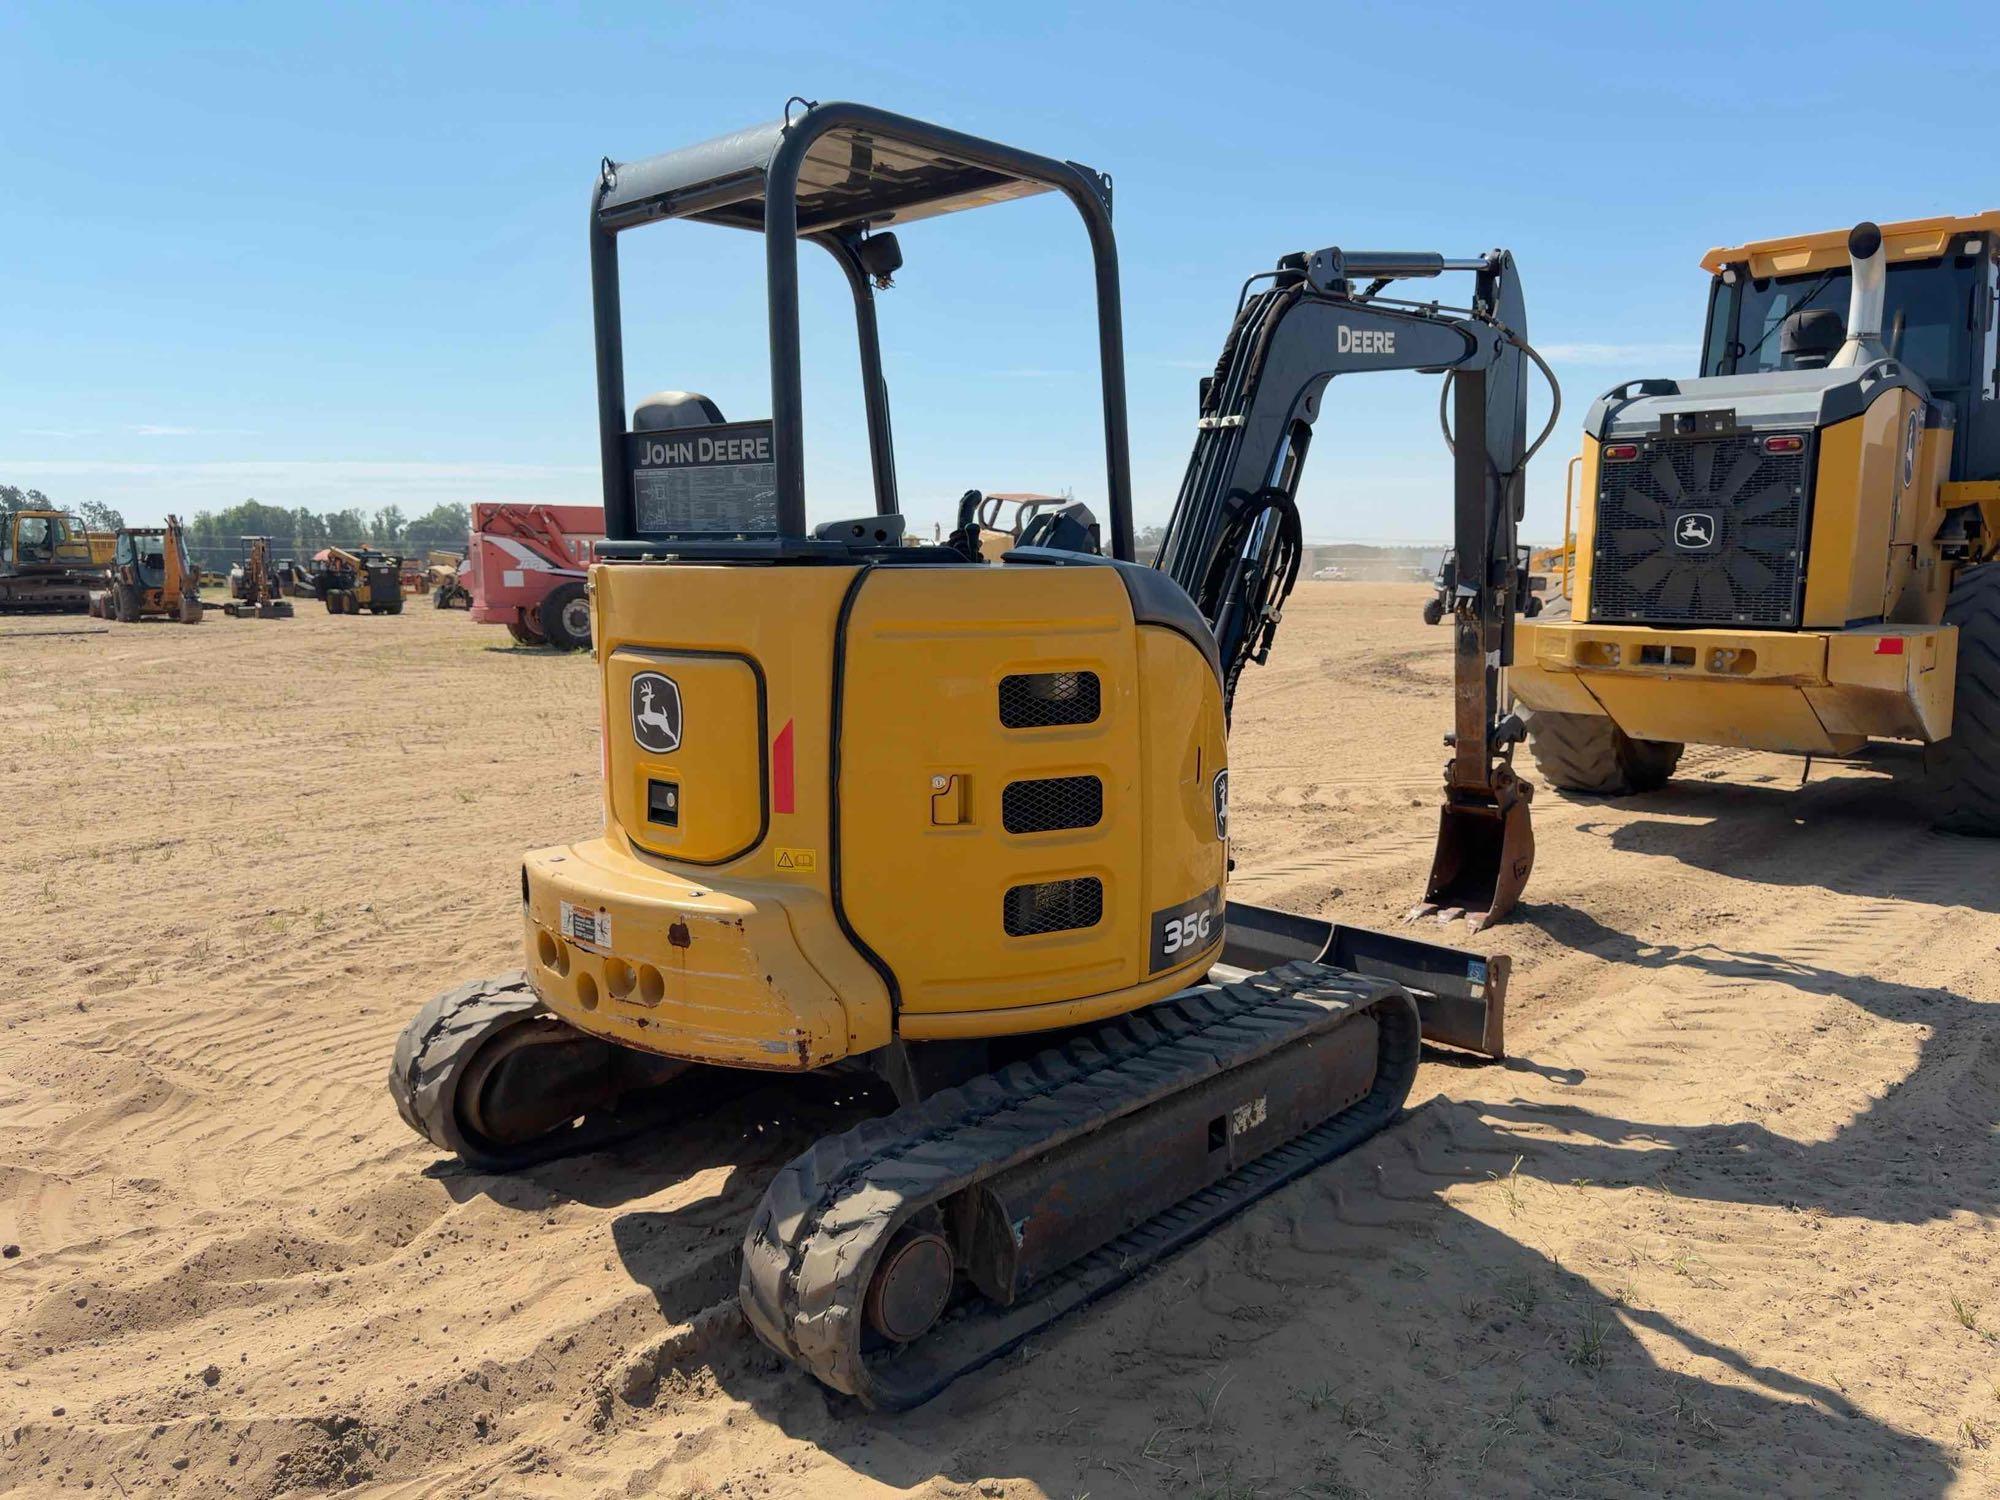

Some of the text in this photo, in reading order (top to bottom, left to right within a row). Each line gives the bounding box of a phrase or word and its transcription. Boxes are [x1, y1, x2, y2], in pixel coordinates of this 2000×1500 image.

[1337, 325, 1395, 353] DEERE
[641, 437, 769, 465] JOHN DEERE
[1163, 909, 1210, 954] 35G
